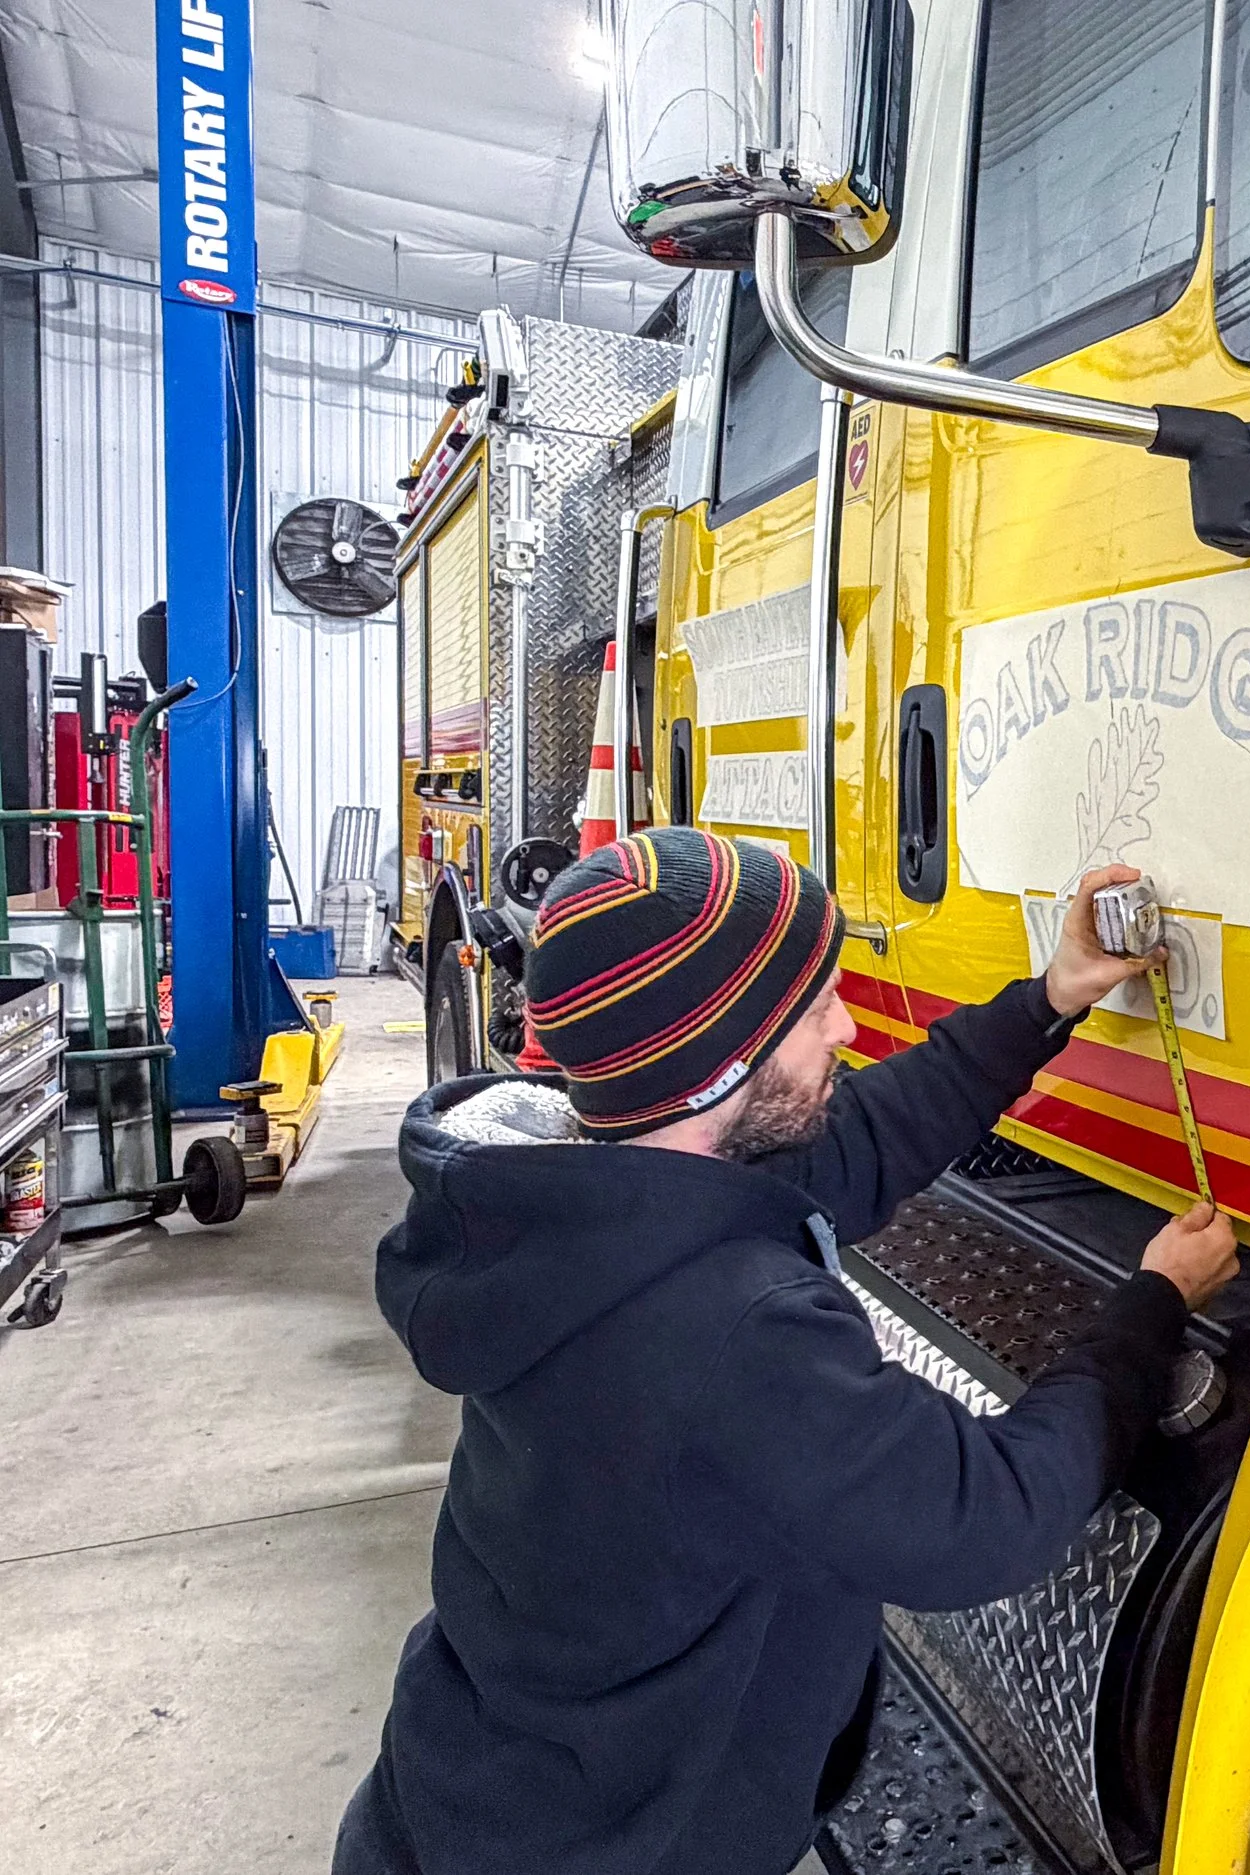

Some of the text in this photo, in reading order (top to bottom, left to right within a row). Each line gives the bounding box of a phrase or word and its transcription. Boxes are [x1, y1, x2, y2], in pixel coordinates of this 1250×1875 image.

[182, 76, 229, 273] ROTARY
[851, 413, 871, 441] AED
[958, 619, 1071, 787] OAK
[119, 739, 131, 807] HUNTER
